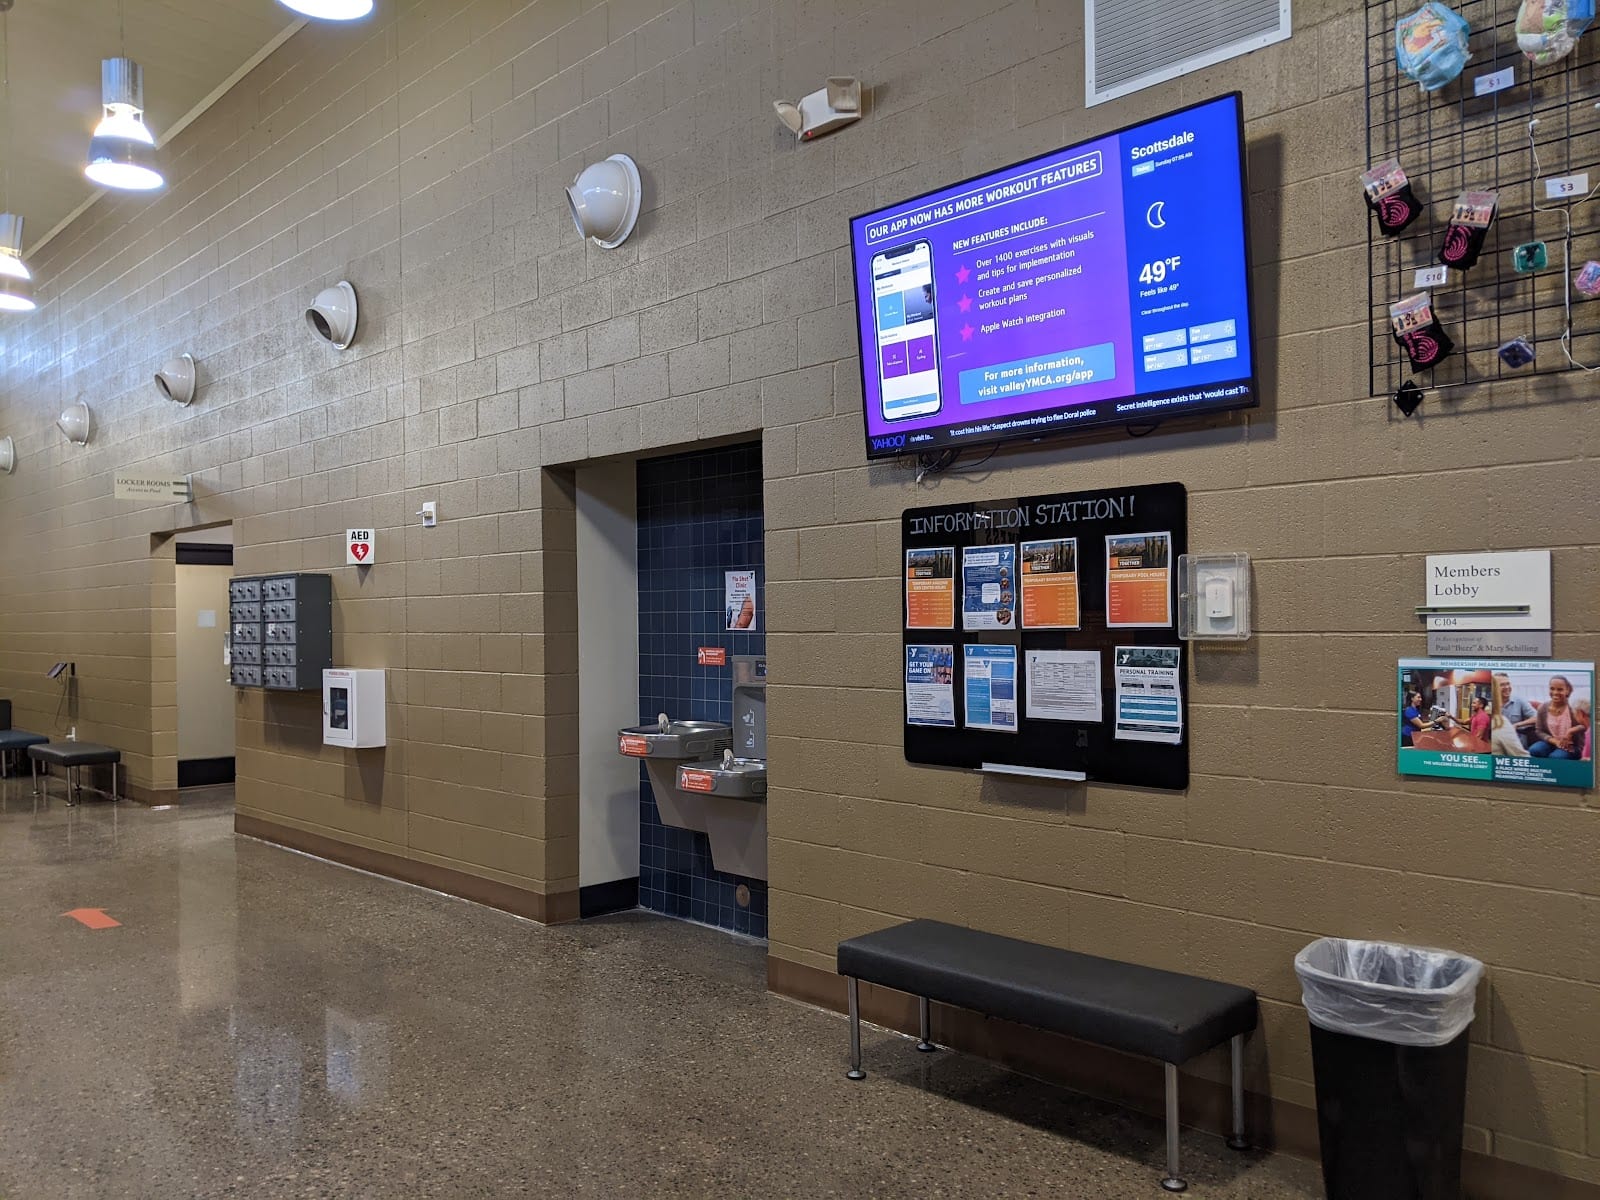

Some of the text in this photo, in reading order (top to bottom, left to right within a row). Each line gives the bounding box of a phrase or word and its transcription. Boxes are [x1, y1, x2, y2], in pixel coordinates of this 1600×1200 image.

[1131, 131, 1195, 160] Scottsdale
[1155, 158, 1171, 167] Sunday
[1559, 183, 1574, 192] $3
[869, 158, 1098, 239] OUR APP NOW HAS MORE WORKOUT FEATURES
[953, 216, 1048, 250] NEW FEATURES INCLUDE:
[976, 230, 1094, 269] Over 1400 exercises with visuals
[977, 249, 1075, 281] and tips for implementation
[978, 264, 1082, 298] Create and save personalized
[1425, 273, 1442, 282] $10
[1139, 288, 1157, 298] Feels
[1157, 286, 1168, 294] like
[979, 292, 1028, 311] workout plans
[981, 307, 1066, 335] Apple Watch integration
[984, 356, 1085, 382] For more information,
[978, 368, 1094, 397] visit valleyYMCA.org/app
[1116, 401, 1136, 412] Secret
[1136, 397, 1170, 409] intelligence
[1171, 394, 1188, 404] exists
[1189, 392, 1202, 400] that
[1225, 387, 1239, 395] cast
[992, 421, 1011, 430] Suspect
[1012, 418, 1030, 427] drowns
[1031, 416, 1046, 425] trying
[1064, 410, 1079, 419] Doral
[1080, 408, 1097, 418] police
[872, 434, 906, 450] YAHOO!
[117, 479, 145, 487] LOCKER
[909, 495, 1135, 534] INFORMATION STATION!
[351, 530, 369, 540] AED
[1434, 564, 1501, 578] Members
[1434, 583, 1480, 598] Lobby
[1434, 618, 1457, 626] C104
[1435, 644, 1451, 652] Paul
[1477, 644, 1484, 652] &
[1485, 644, 1504, 653] Mary
[1505, 644, 1539, 653] Schilling
[1440, 753, 1460, 762] YOU
[1495, 757, 1511, 766] WE
